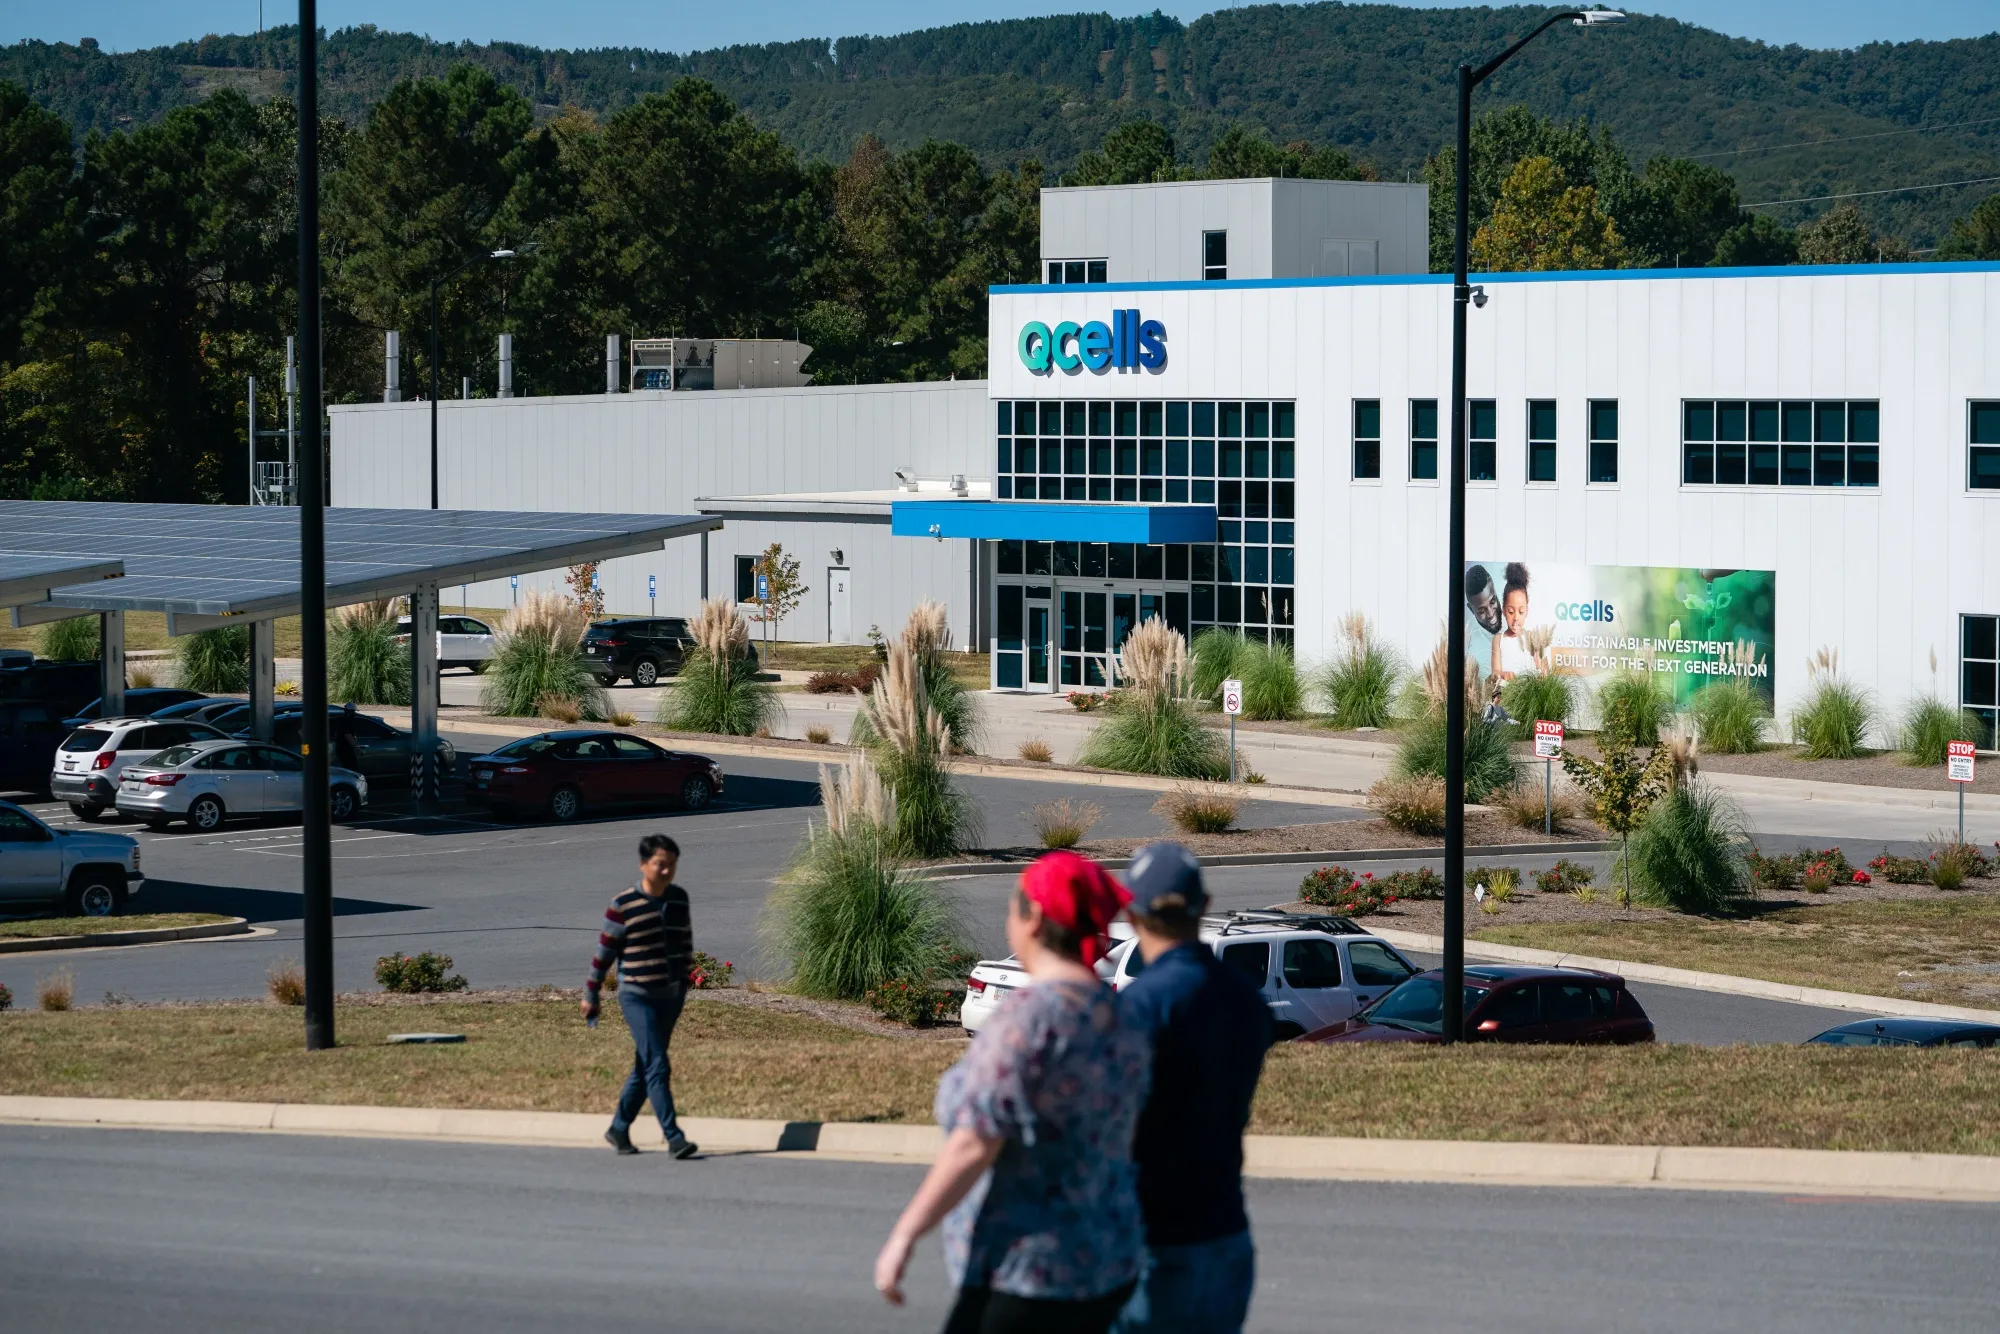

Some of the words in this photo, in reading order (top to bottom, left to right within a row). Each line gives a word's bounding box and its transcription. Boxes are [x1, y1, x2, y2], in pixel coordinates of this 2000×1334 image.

[1018, 309, 1168, 373] Qcells
[1555, 600, 1614, 622] Qcells
[1556, 635, 1564, 647] A
[1568, 635, 1651, 651] SUSTAINABLE
[1654, 639, 1734, 654] INVESTMENT
[1555, 653, 1588, 668] BUILT
[1591, 656, 1617, 669] FOR
[1620, 657, 1645, 671] THE
[1684, 660, 1767, 677] GENERATION
[1536, 722, 1562, 734] STOP
[1950, 742, 1974, 754] STOP
